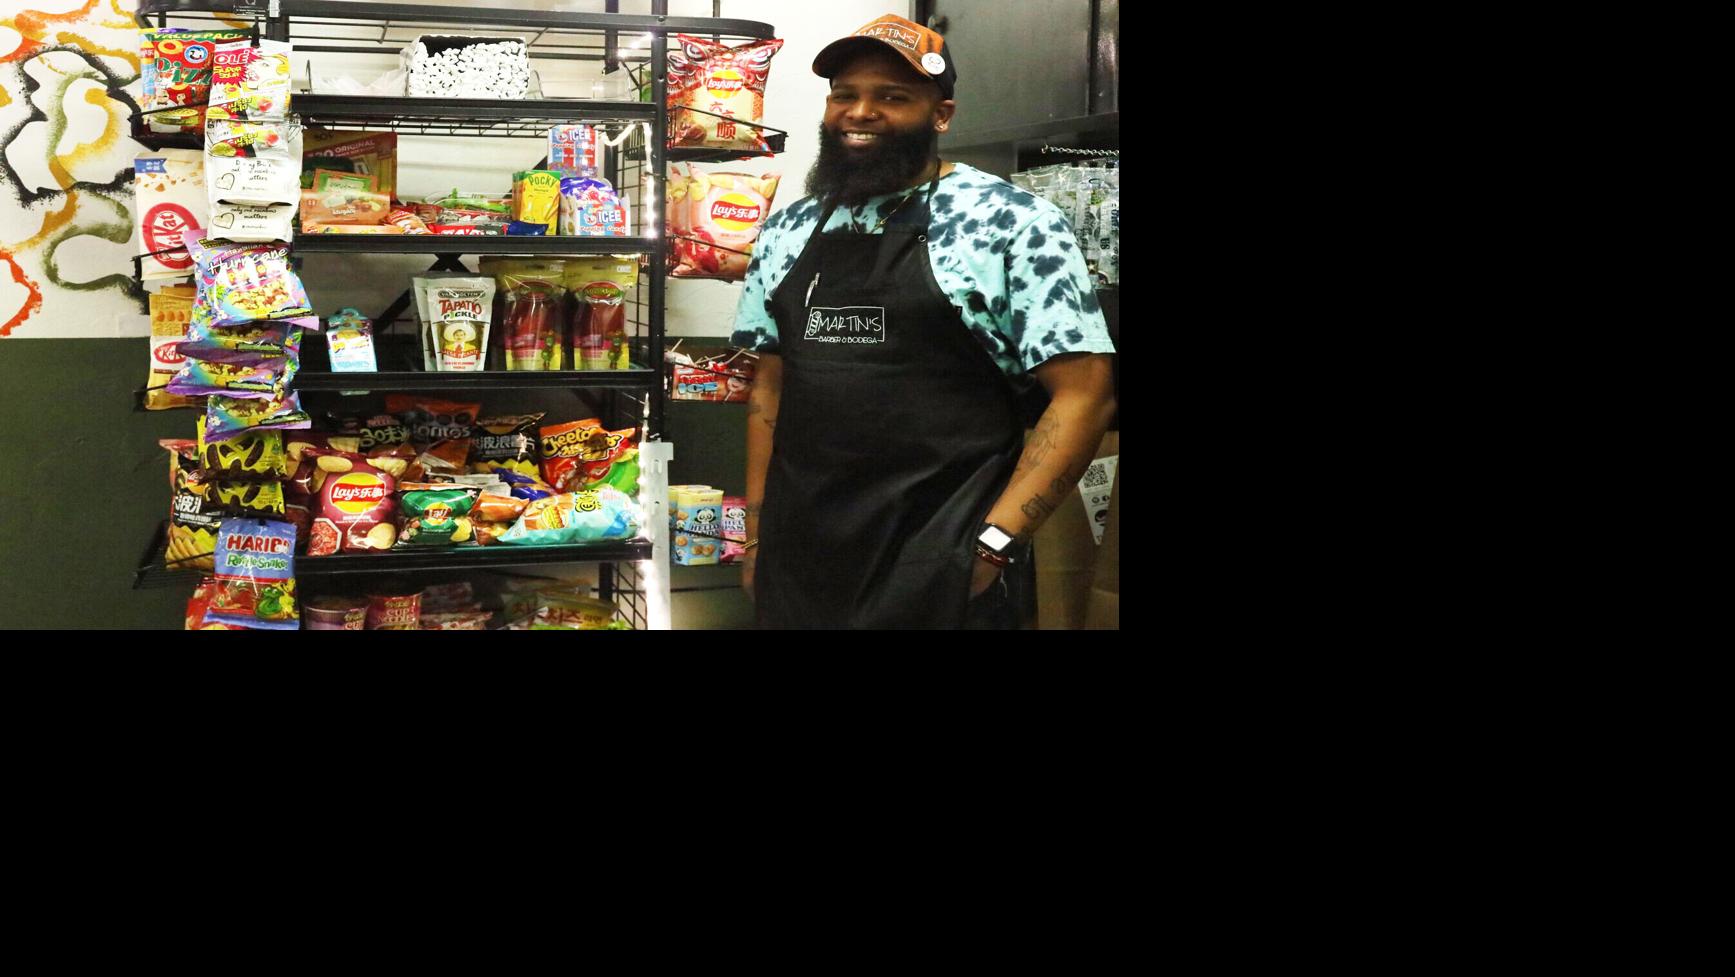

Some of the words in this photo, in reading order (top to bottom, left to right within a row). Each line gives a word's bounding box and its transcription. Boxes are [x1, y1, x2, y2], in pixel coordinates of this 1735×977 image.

[154, 57, 212, 85] Pizz
[568, 129, 592, 142] ICEE
[335, 139, 376, 153] ORIGINAL
[597, 210, 623, 224] ICEE
[818, 316, 882, 332] MARTIN'S
[415, 425, 472, 439] oritos
